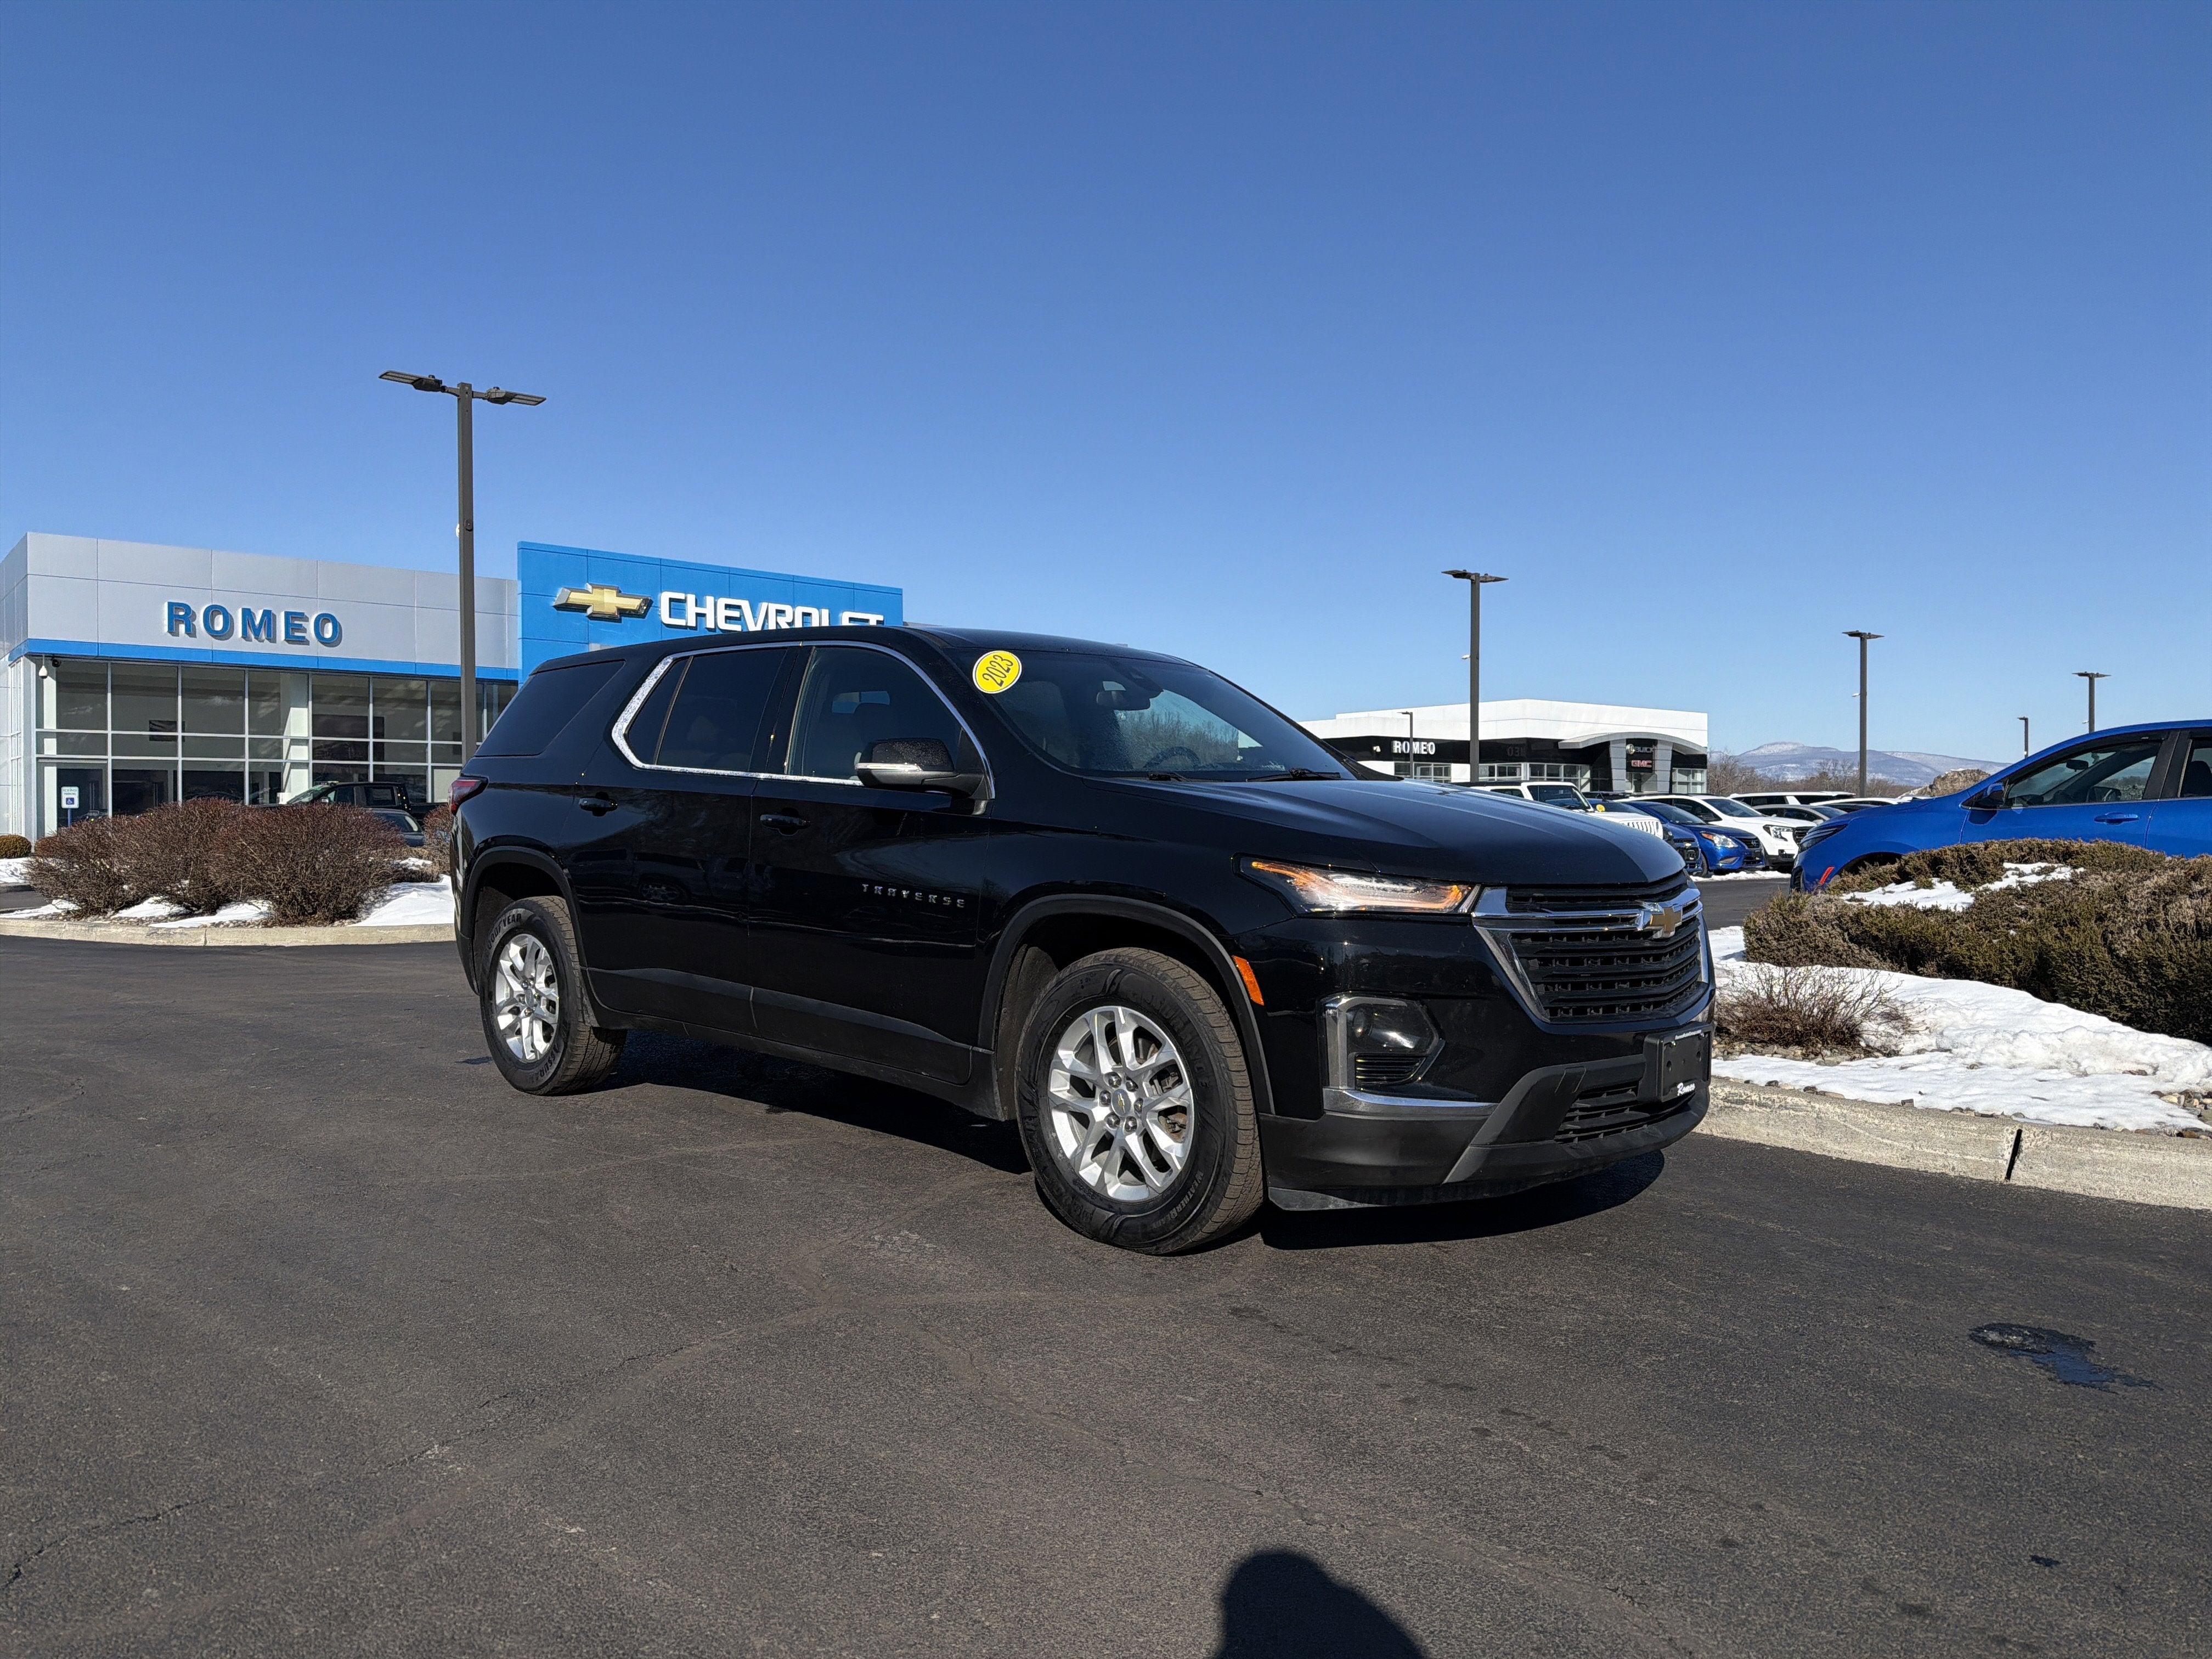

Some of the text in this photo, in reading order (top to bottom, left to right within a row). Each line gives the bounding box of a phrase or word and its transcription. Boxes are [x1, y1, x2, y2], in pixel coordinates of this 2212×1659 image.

[166, 601, 340, 643] ROMEO
[982, 655, 1013, 687] 2023
[1392, 740, 1436, 755] ROMEO
[862, 883, 965, 909] TRAVERSE
[487, 913, 522, 951] OODYEAR
